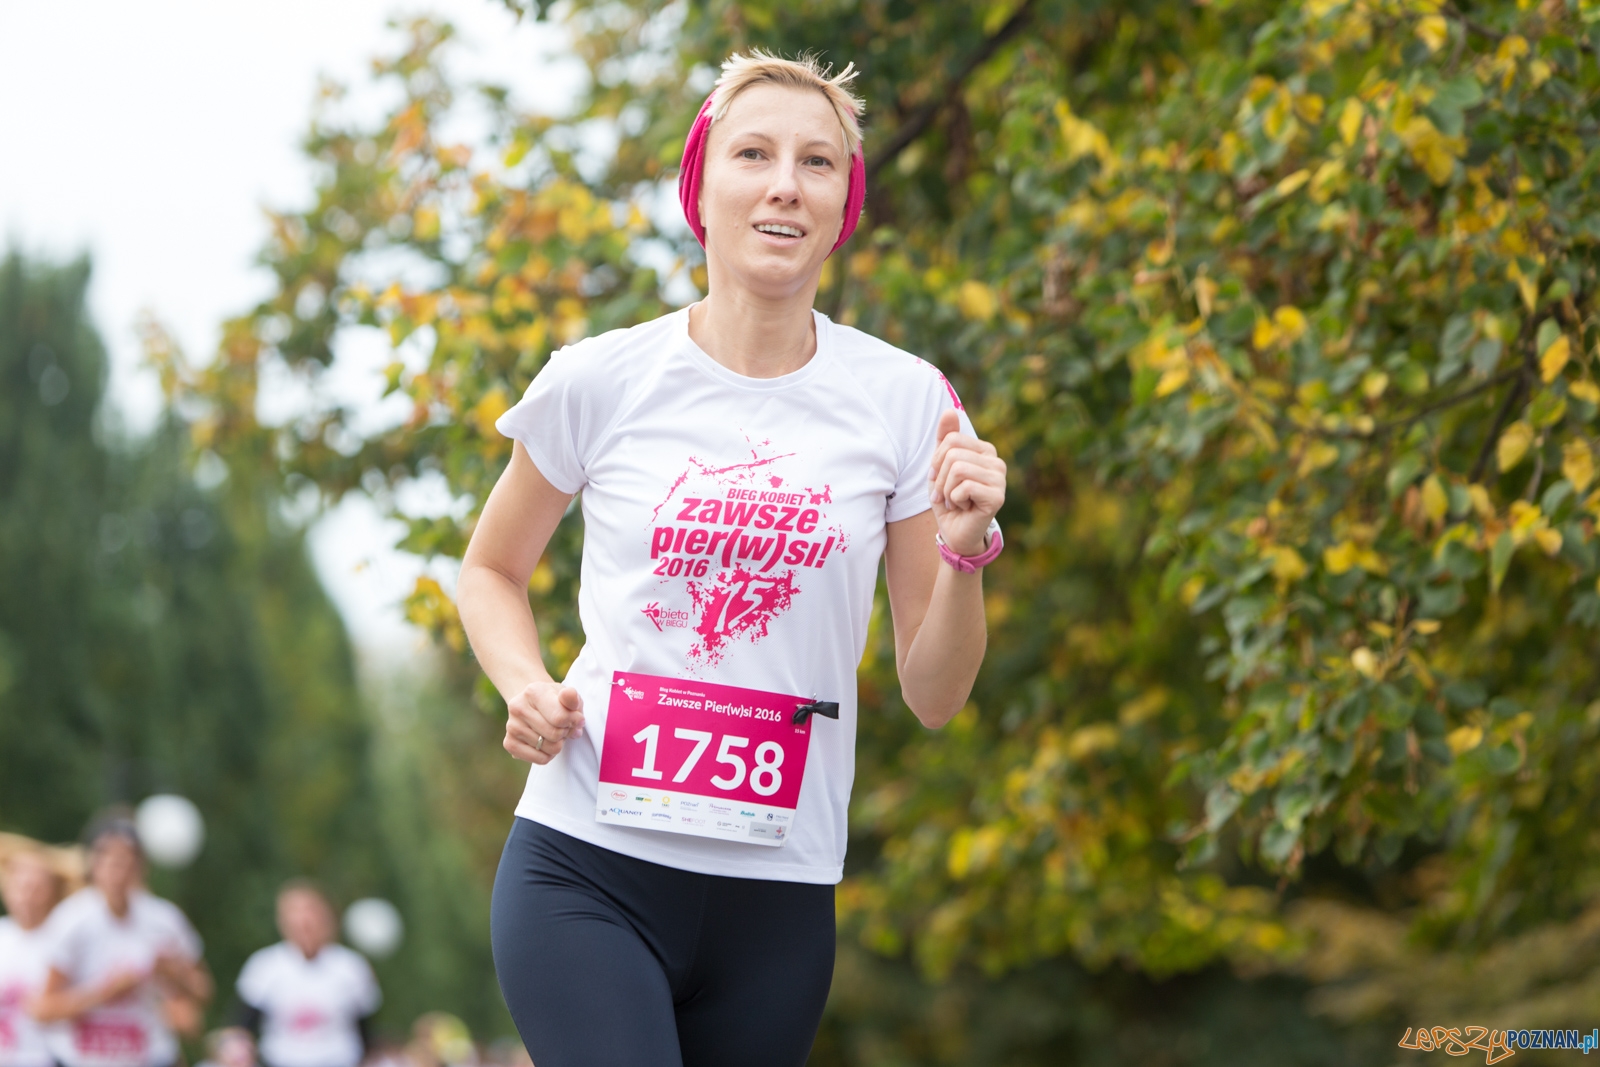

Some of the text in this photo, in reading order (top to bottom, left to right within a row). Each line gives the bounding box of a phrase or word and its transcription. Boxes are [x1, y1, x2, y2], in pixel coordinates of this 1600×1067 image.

[727, 488, 806, 506] BIEG KOBIET
[676, 497, 819, 534] zawsze
[653, 556, 710, 578] 2016
[713, 579, 777, 633] 15
[665, 619, 688, 628] BIEGU
[657, 693, 782, 723] Zawsze Pier(w)si 2016
[631, 723, 786, 797] 1758
